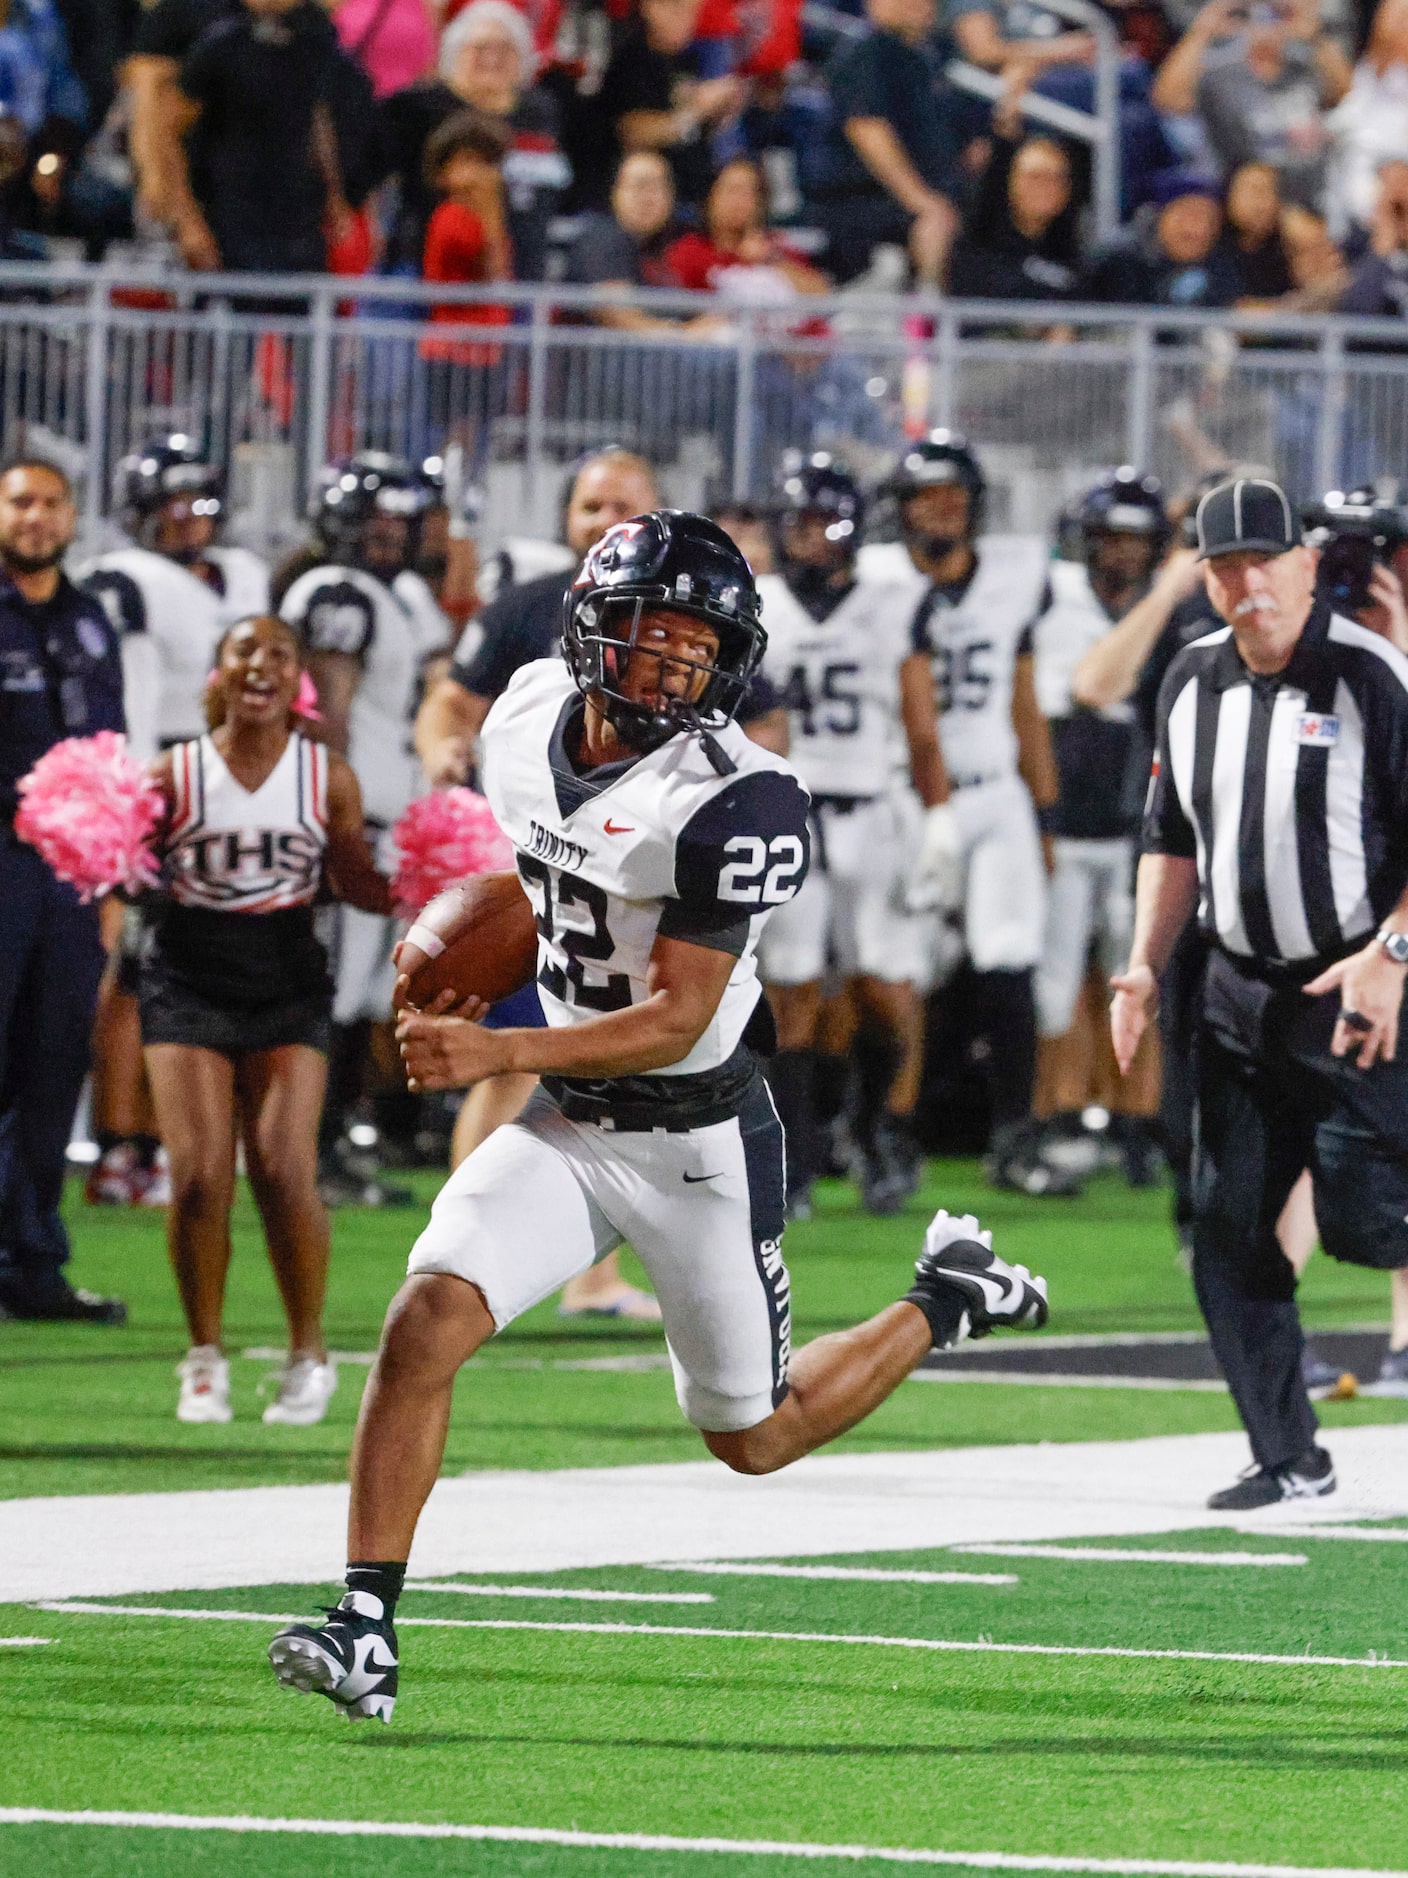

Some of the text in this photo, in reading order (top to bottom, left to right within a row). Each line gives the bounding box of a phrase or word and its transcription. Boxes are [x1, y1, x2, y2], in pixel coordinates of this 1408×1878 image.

[176, 828, 323, 877] THS
[525, 819, 589, 871] TRINITY
[717, 834, 804, 904] 22
